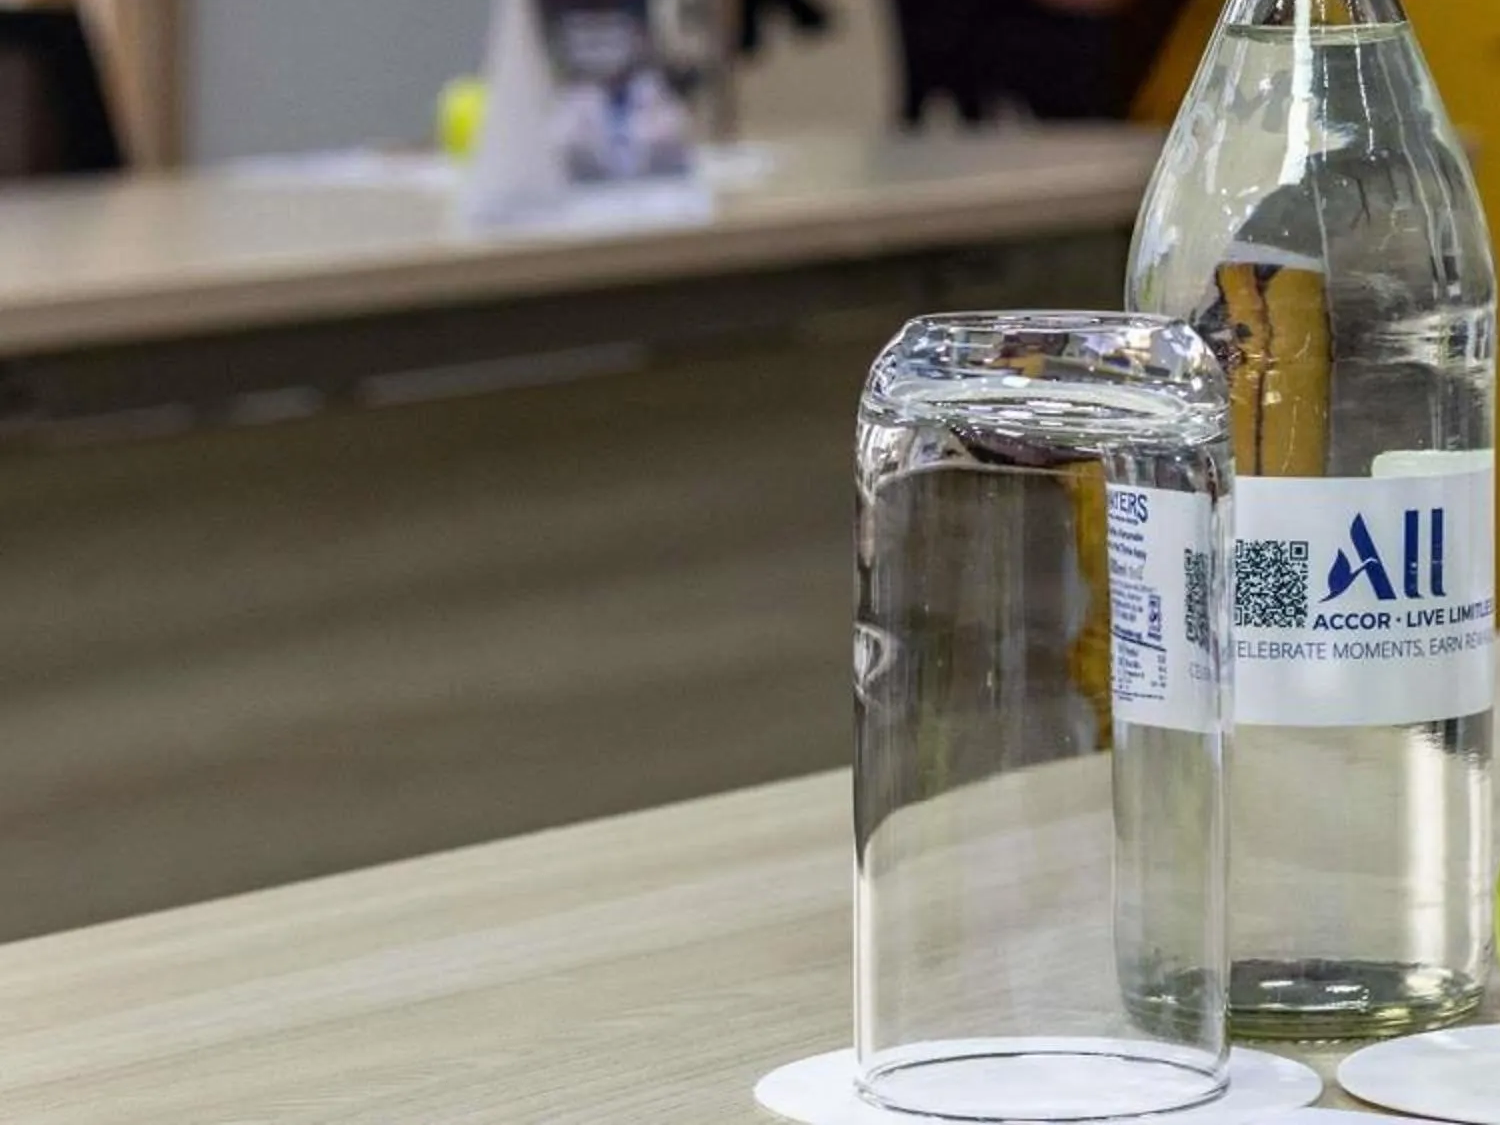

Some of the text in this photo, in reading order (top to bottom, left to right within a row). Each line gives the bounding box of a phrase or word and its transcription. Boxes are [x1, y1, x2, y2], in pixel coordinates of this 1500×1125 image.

[1312, 612, 1392, 631] ACCOR
[1406, 607, 1445, 628] LIVE
[1233, 640, 1327, 661] ELEBRATE
[1429, 635, 1463, 656] EARN
